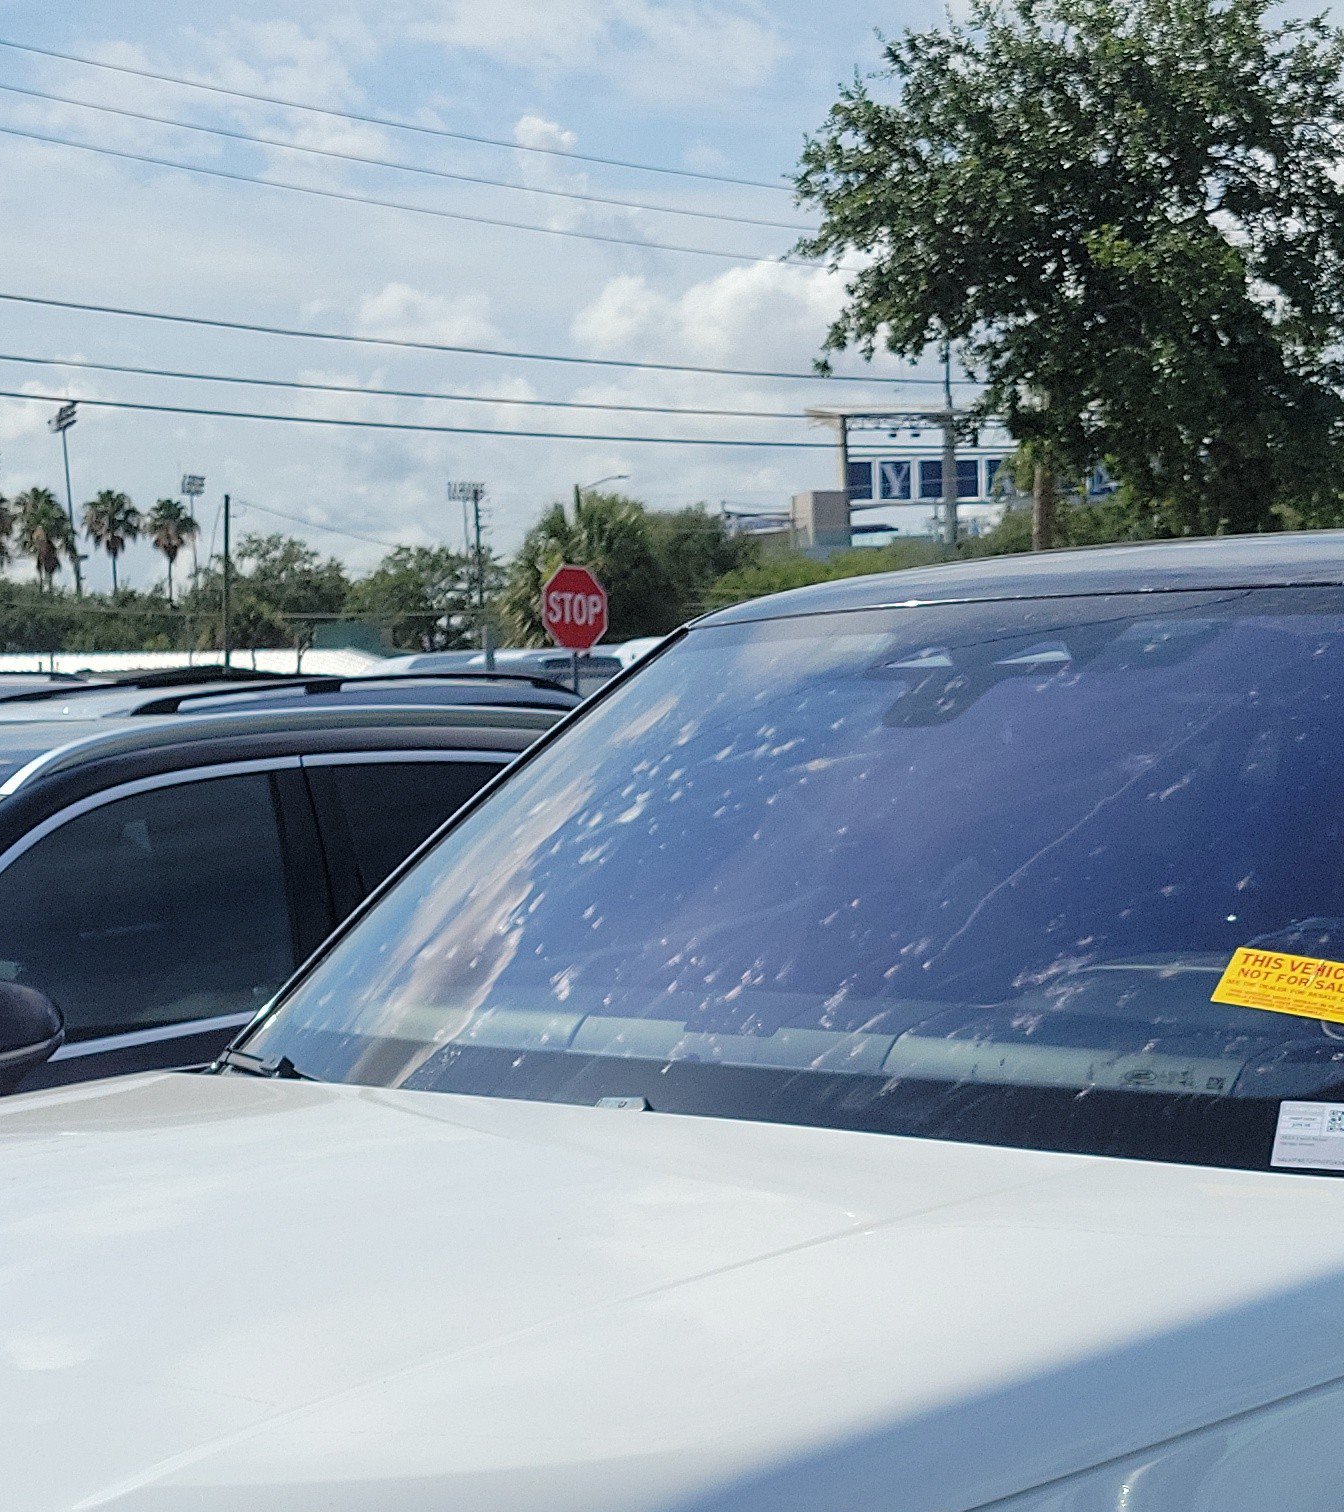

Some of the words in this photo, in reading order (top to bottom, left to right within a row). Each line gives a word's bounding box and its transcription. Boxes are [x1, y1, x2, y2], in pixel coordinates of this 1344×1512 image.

[547, 590, 603, 626] STOP
[1242, 952, 1285, 970] THIS
[1237, 967, 1273, 981] NOT
[1275, 973, 1309, 987] FOR
